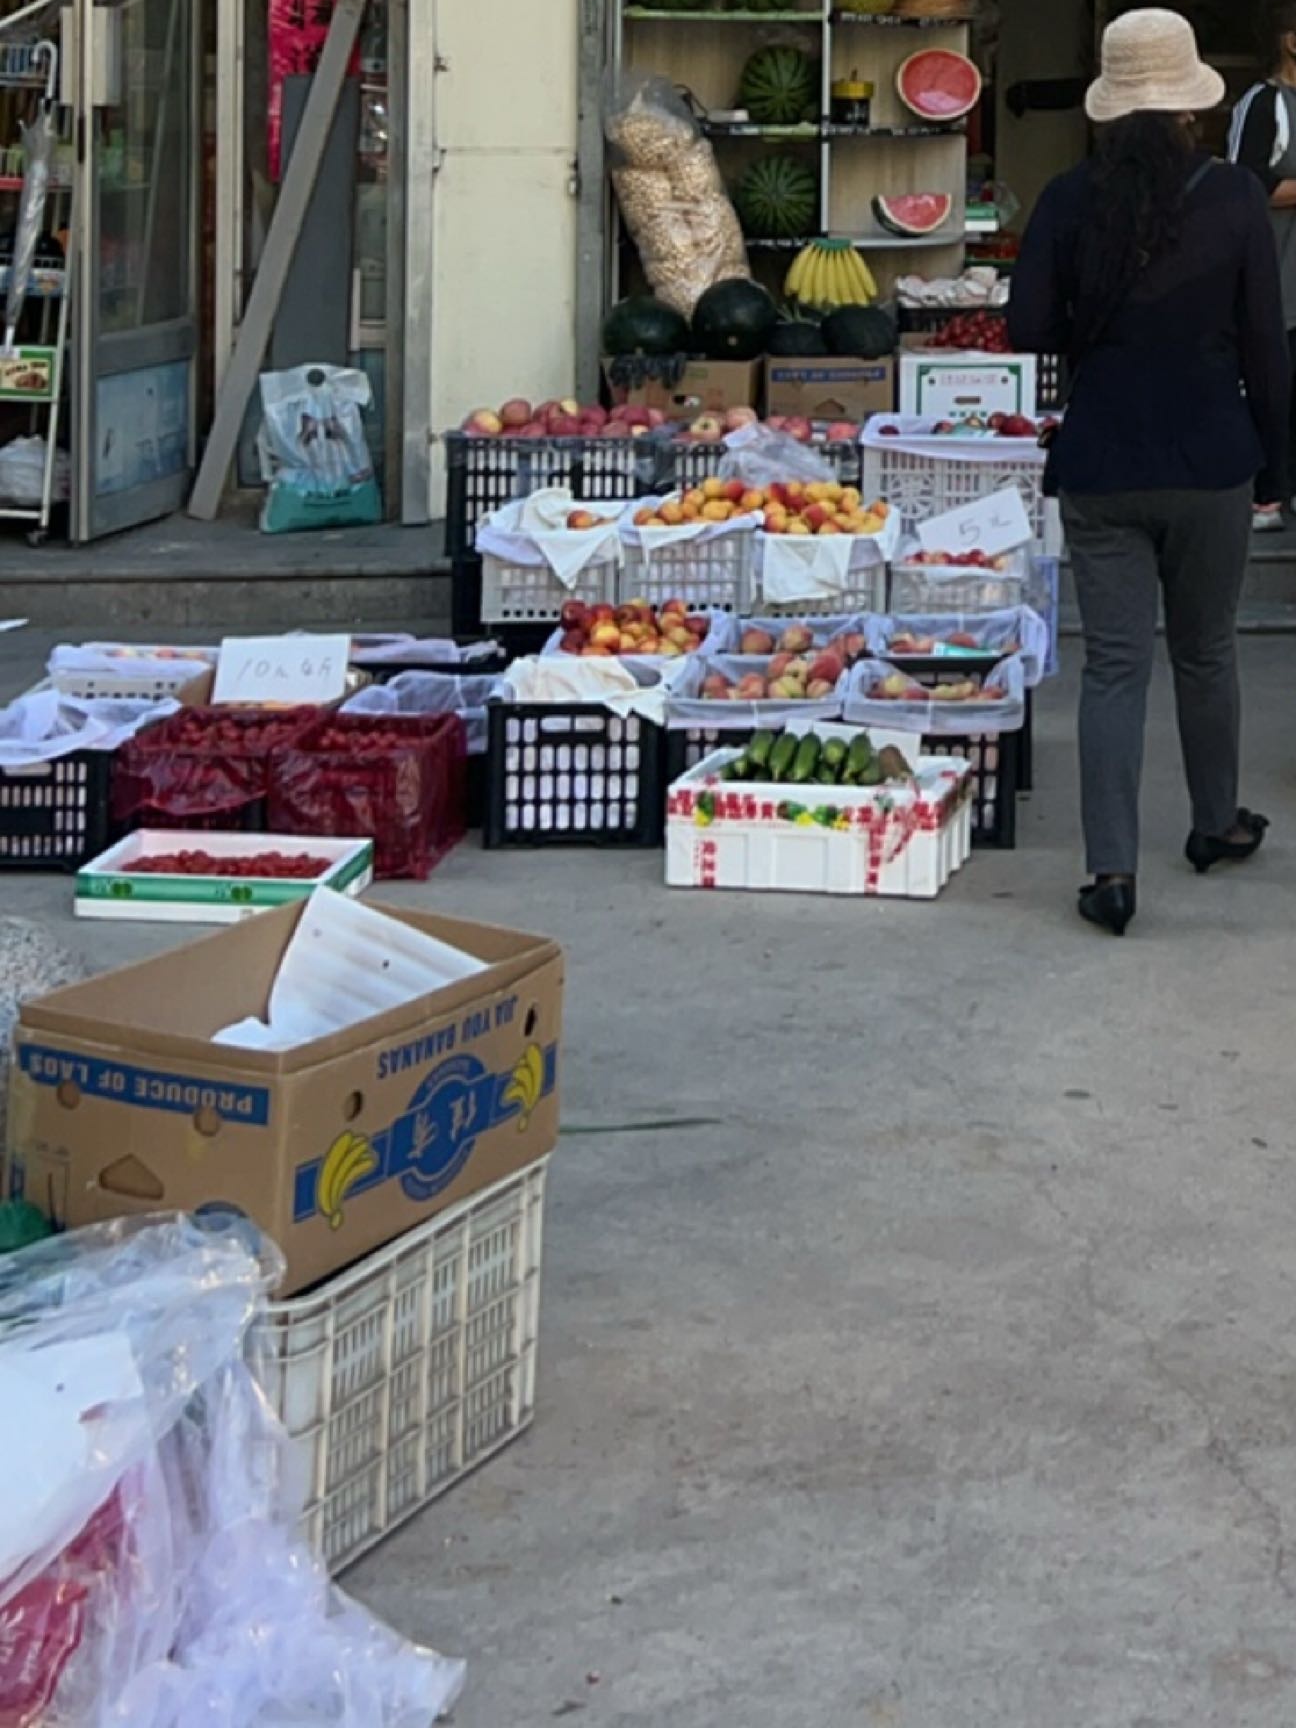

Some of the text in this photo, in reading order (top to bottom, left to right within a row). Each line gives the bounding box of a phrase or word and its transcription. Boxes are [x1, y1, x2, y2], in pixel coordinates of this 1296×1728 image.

[376, 1023, 458, 1080] BANANAS
[99, 1068, 126, 1092] OF
[134, 1076, 253, 1115] PRODUCE
